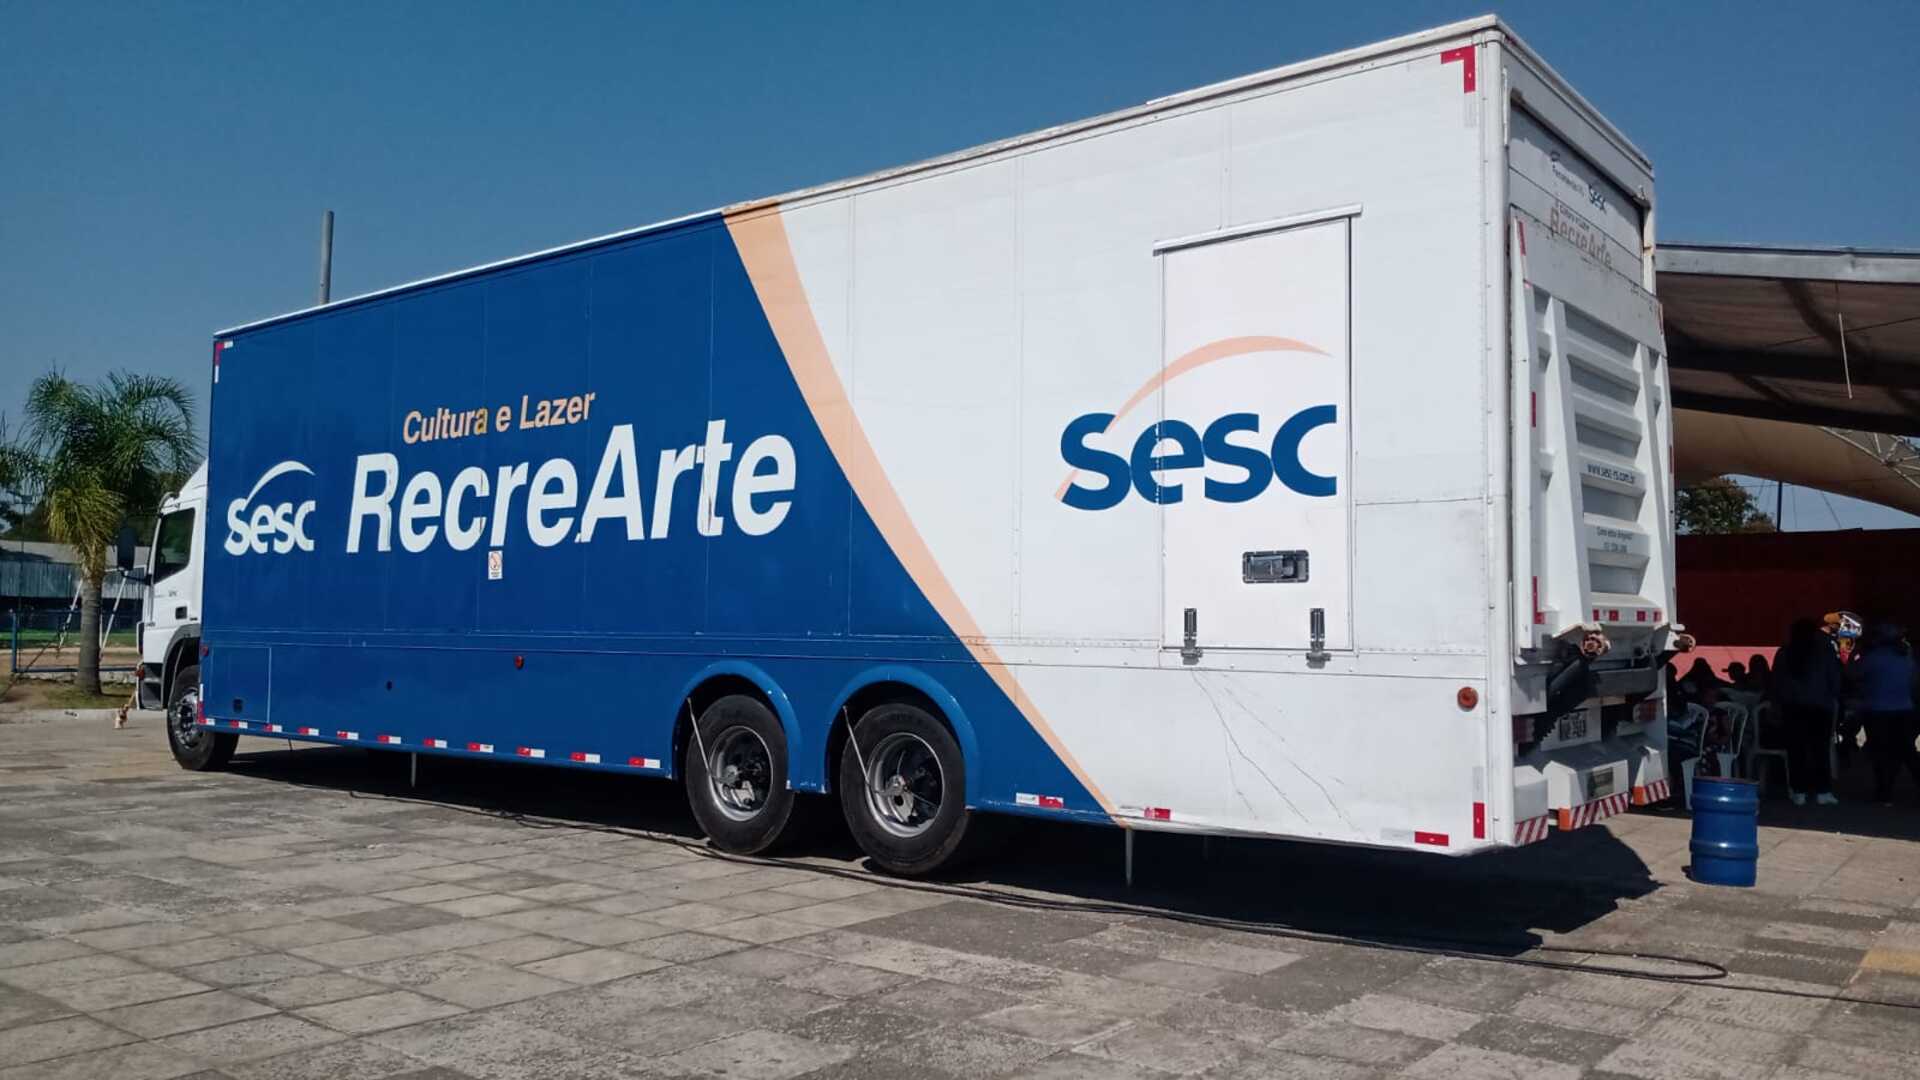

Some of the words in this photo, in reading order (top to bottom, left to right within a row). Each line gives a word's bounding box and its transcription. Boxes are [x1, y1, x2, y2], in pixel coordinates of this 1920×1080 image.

[403, 406, 488, 445] Cultura
[496, 404, 510, 431] e
[519, 391, 596, 430] Lazer
[346, 419, 797, 554] RecreArte
